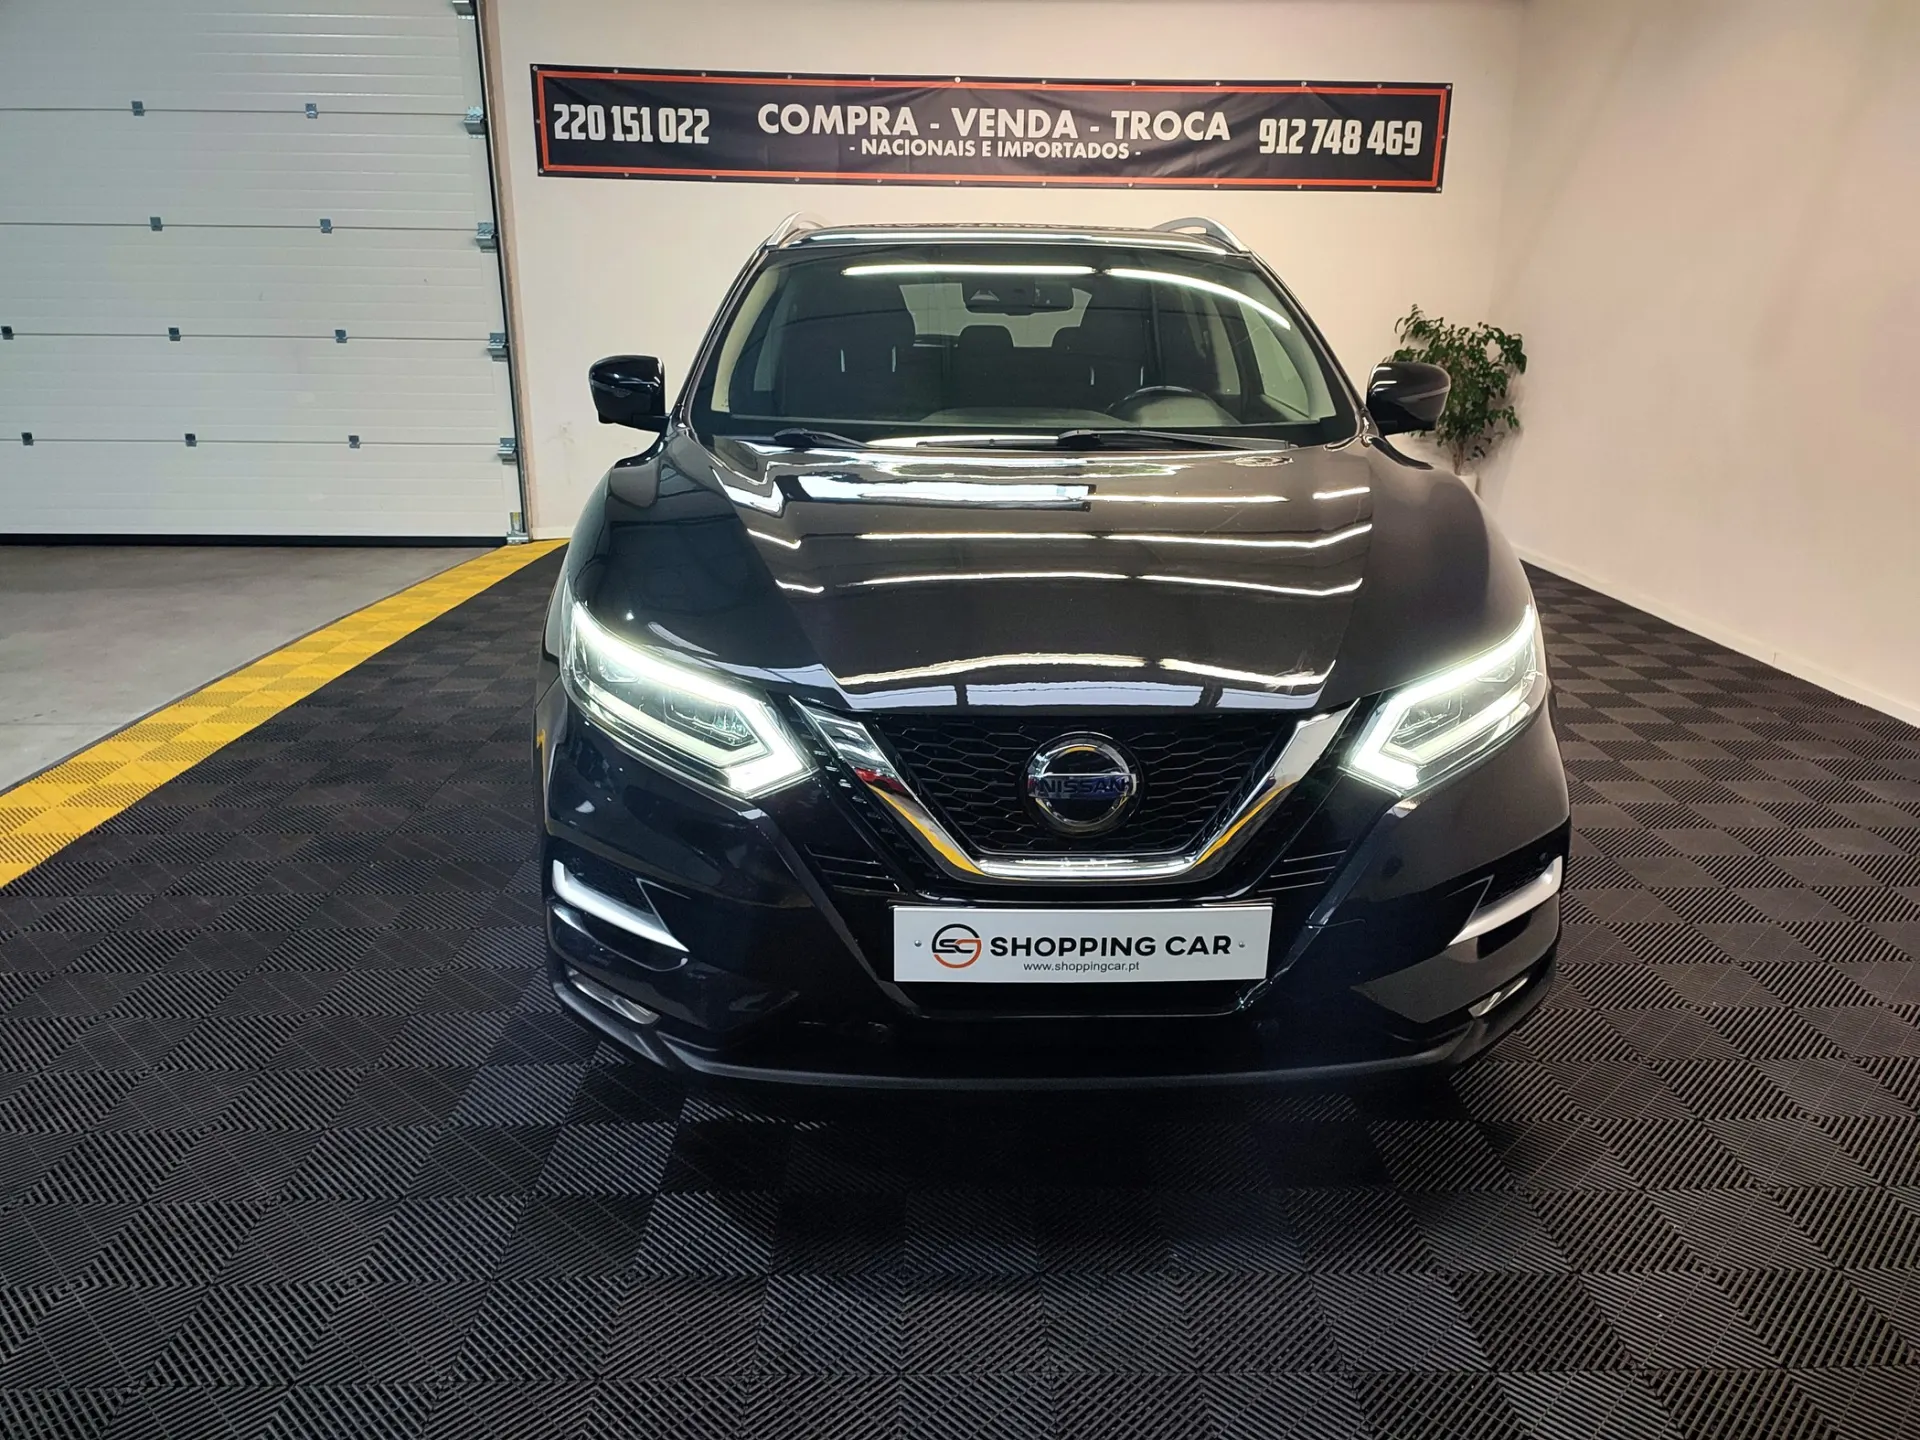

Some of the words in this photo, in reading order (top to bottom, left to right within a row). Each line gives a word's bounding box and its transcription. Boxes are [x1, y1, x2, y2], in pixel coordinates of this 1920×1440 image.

[553, 103, 606, 141] 220
[610, 105, 654, 143] 151
[658, 107, 710, 145] 022
[757, 103, 919, 136] COMPRA
[950, 107, 1079, 139] VENDA
[1110, 110, 1231, 141] TROCA
[1258, 118, 1307, 154] 912
[1310, 118, 1362, 155] 748
[1366, 120, 1423, 156] 469
[861, 138, 976, 157] NACIONAIS
[981, 140, 992, 157] E
[997, 140, 1130, 160] IMPORTADOS
[1040, 777, 1126, 794] NISSAN
[990, 936, 1156, 957] SHOPPING
[1165, 935, 1232, 956] CAR
[1023, 961, 1140, 974] www.shoppingcar.pt
